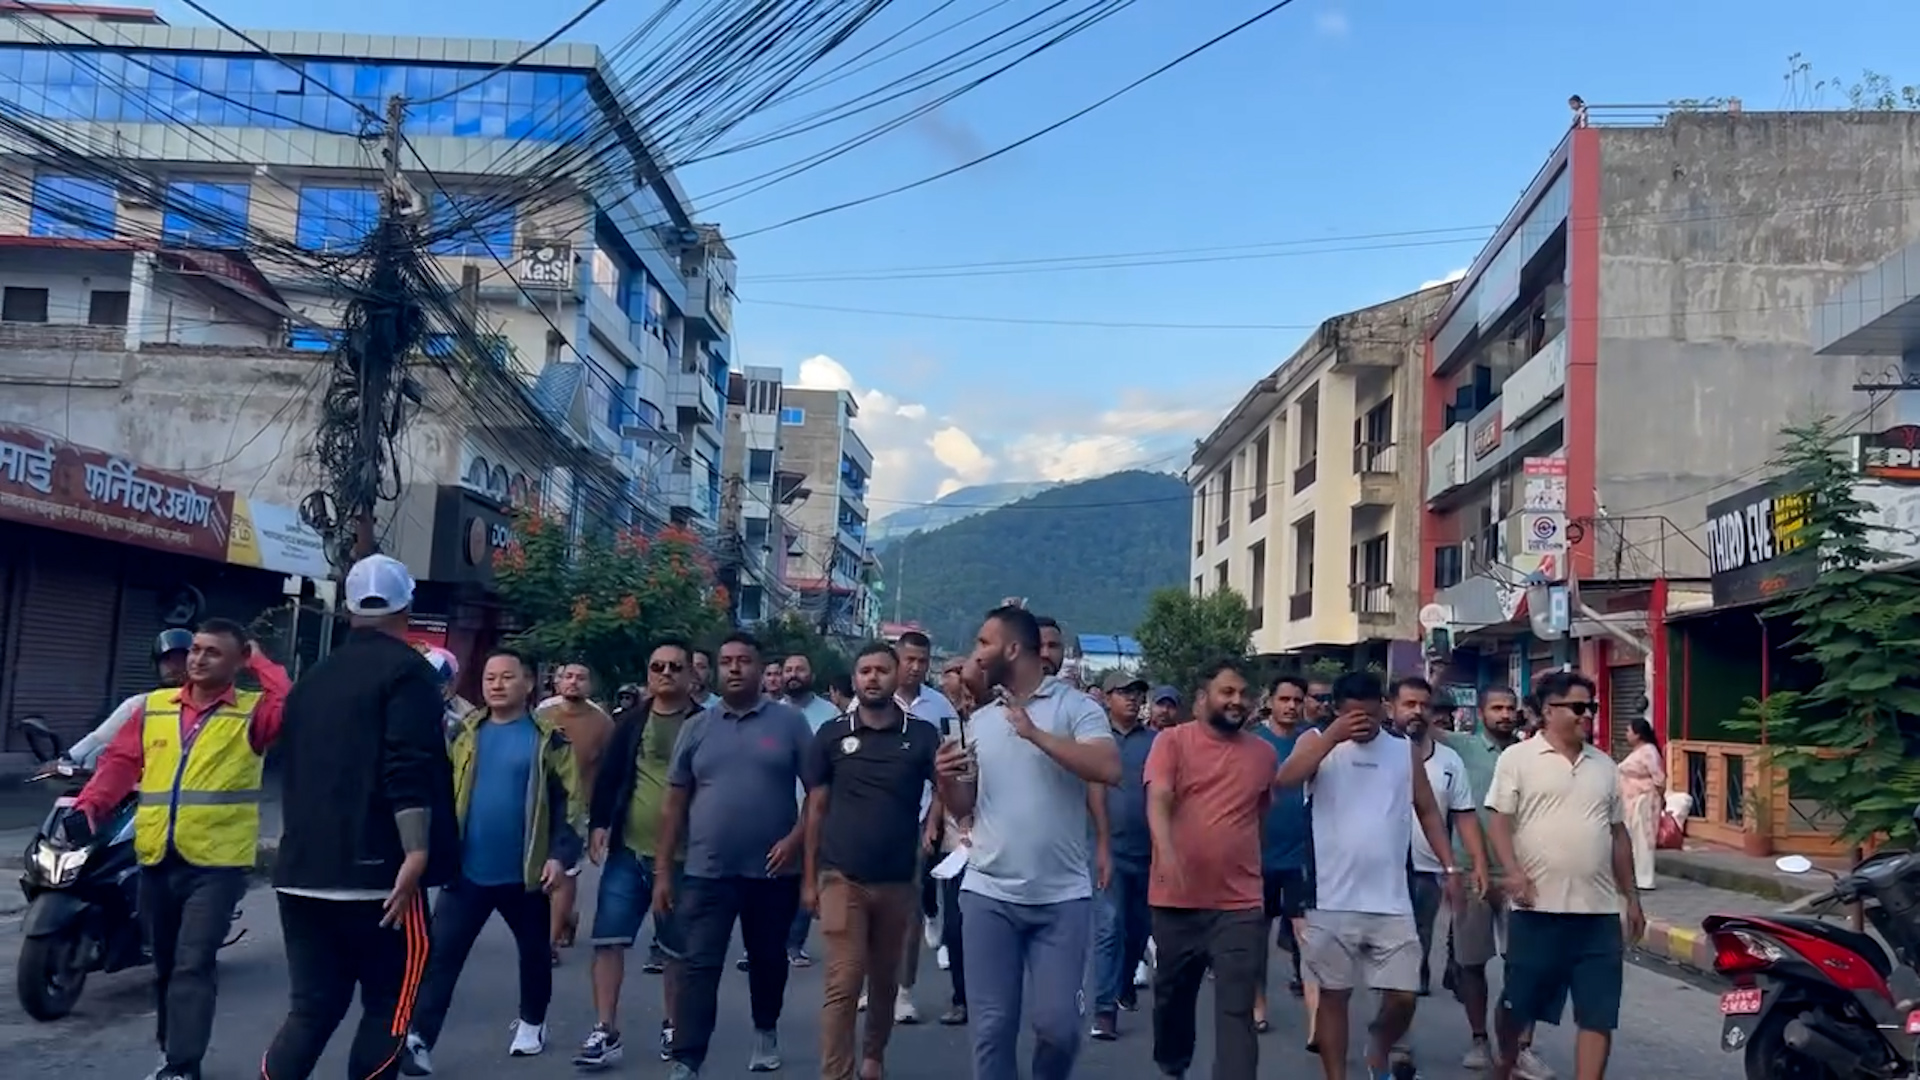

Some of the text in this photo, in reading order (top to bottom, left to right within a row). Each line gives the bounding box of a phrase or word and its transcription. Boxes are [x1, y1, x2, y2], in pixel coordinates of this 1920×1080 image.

[521, 258, 568, 282] Ka:Si
[162, 483, 213, 528] उद्योग
[1707, 510, 1745, 574] THIRD
[1746, 498, 1773, 564] EYE
[1444, 771, 1453, 790] 7
